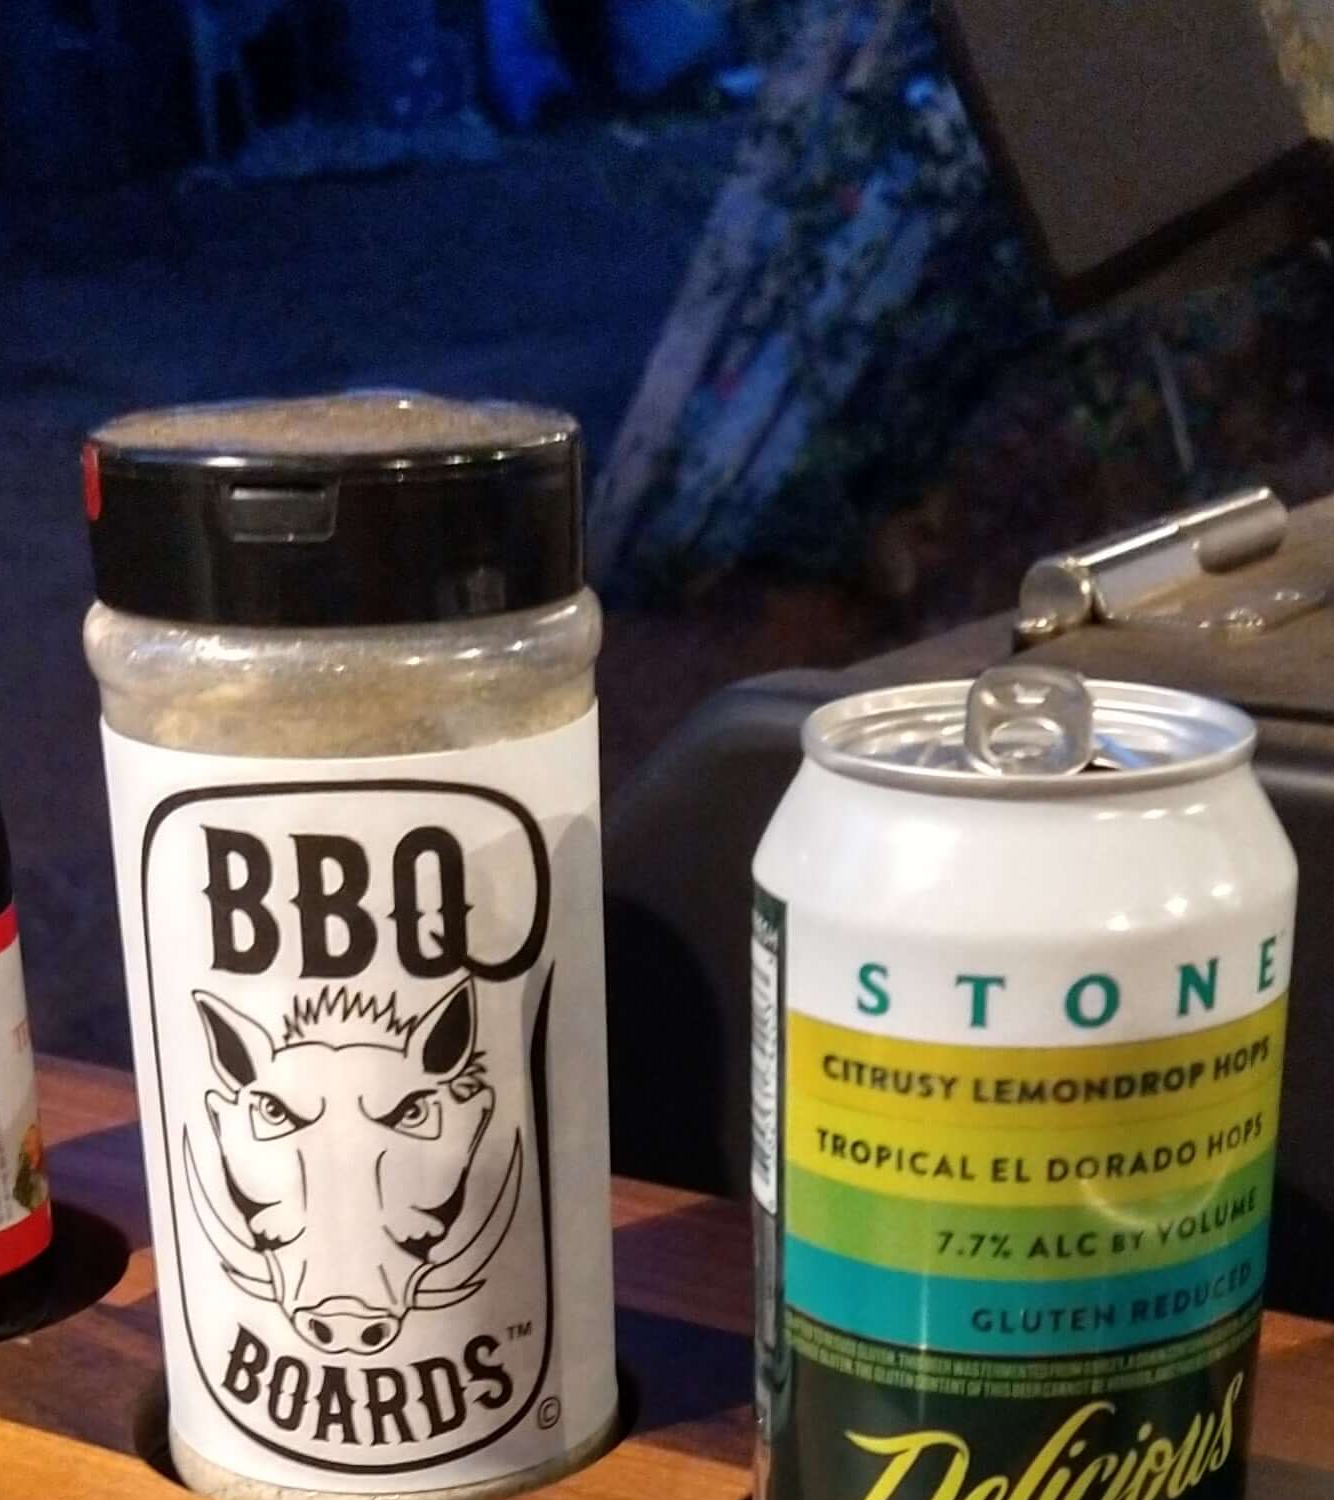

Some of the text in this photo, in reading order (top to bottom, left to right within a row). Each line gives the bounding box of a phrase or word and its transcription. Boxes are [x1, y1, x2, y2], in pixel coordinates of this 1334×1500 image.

[200, 824, 473, 980] BBQ
[856, 935, 1277, 1029] STONE
[822, 1036, 1271, 1105] CITRUSY LEMONDROP HOPS
[816, 1111, 1264, 1184] TROPICAL EL DORADO HOPS
[936, 1186, 1259, 1260] 7.7% ALC BY VOLUME
[970, 1262, 1253, 1334] GLUTEN REDUCED
[221, 1323, 514, 1447] BOARDS
